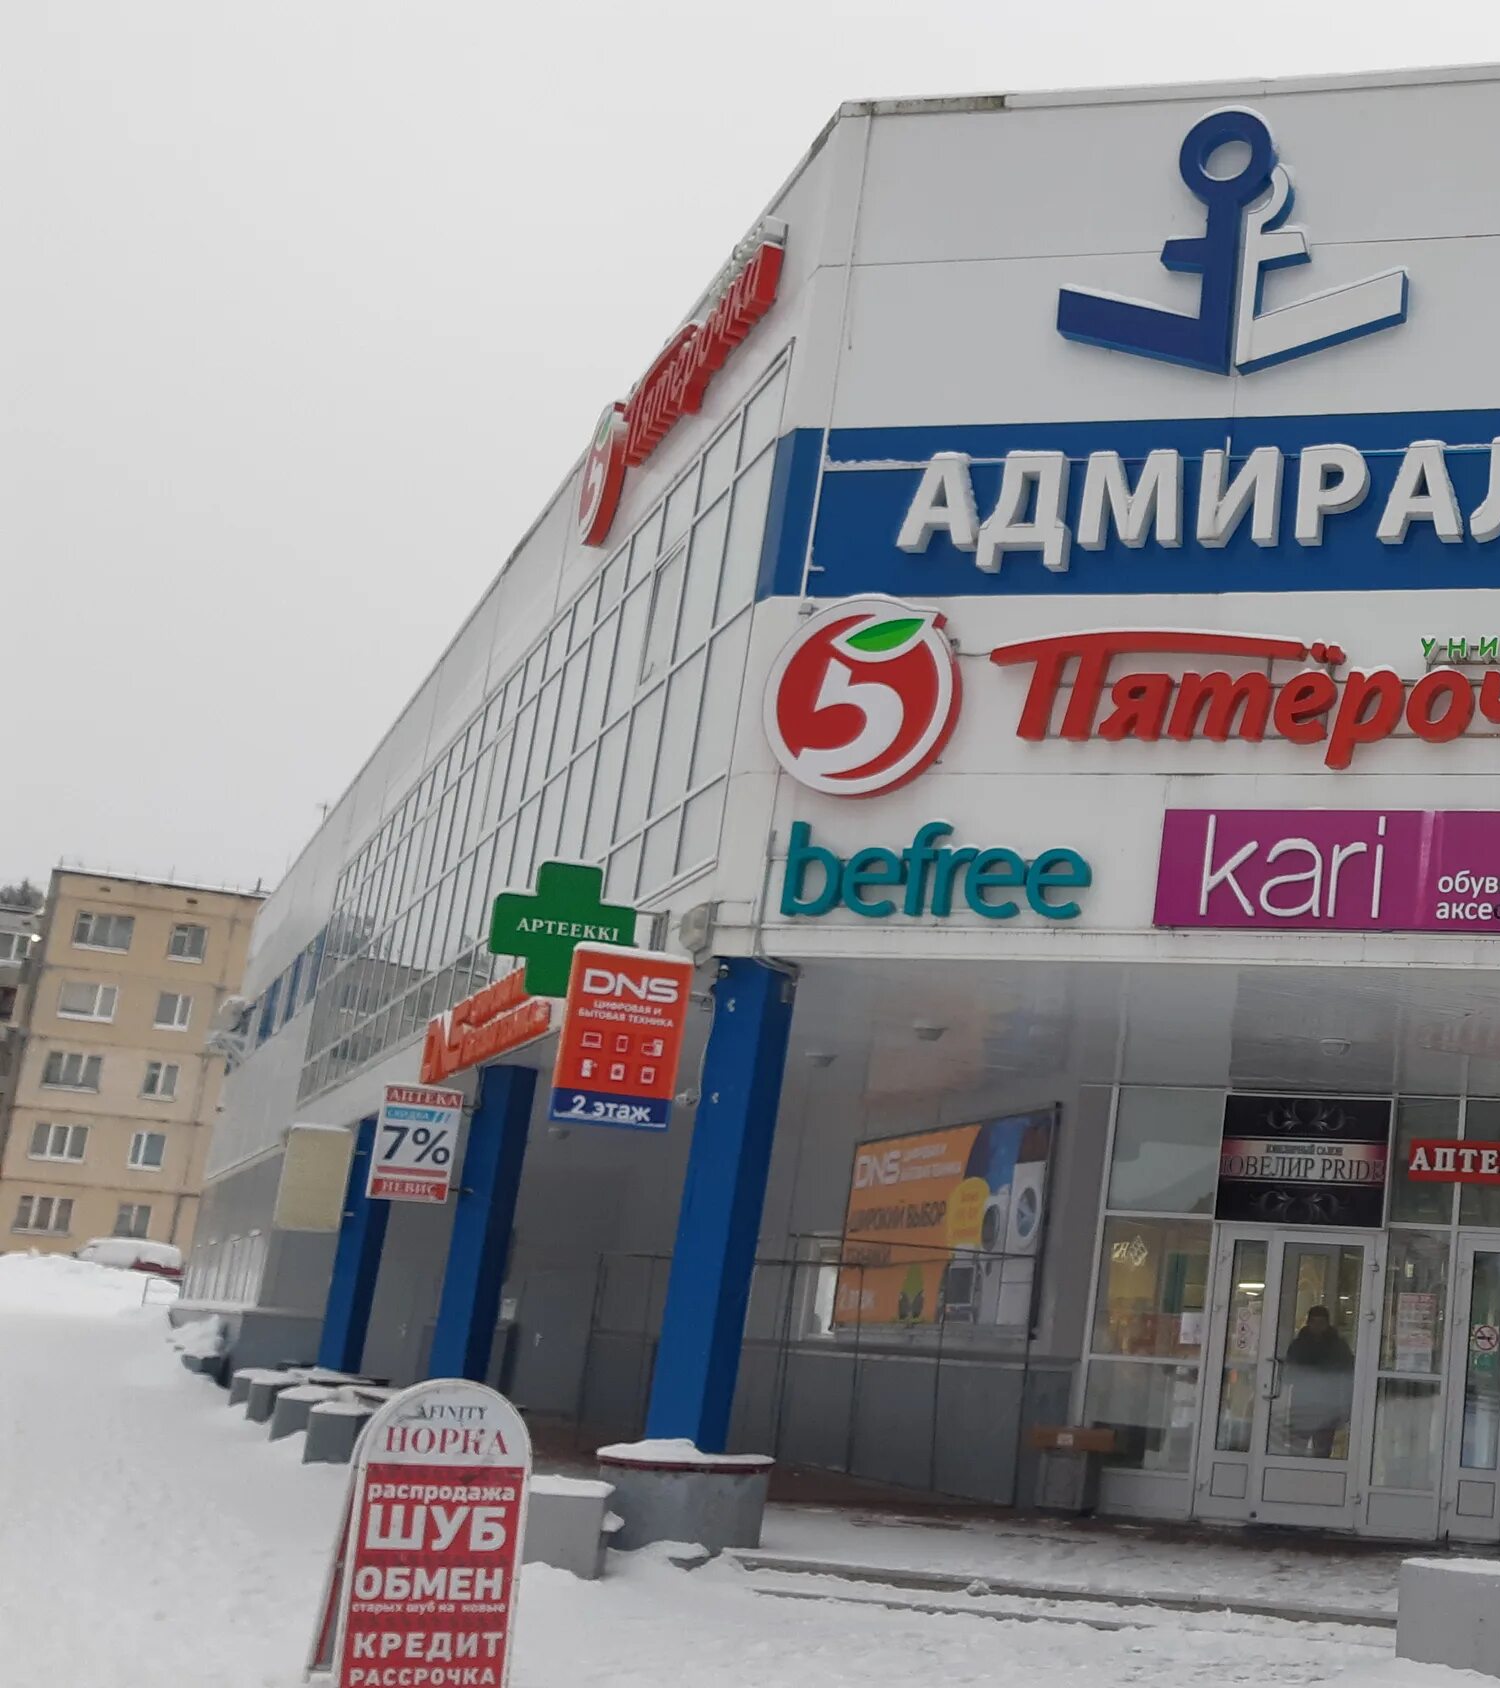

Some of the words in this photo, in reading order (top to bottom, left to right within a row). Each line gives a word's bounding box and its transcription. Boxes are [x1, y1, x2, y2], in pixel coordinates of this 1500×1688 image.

[780, 820, 1092, 919] befree
[1199, 814, 1387, 919] kari
[516, 917, 619, 942] APTEEKKI
[583, 968, 679, 1003] DNS
[578, 1007, 626, 1022] БЫТОВАЯ
[629, 1014, 674, 1028] ТЕХНИКА
[389, 1087, 461, 1106] АПТЕКА
[571, 1094, 587, 1115] 2
[591, 1101, 652, 1122] этаж
[383, 1125, 450, 1165] 7%
[854, 1150, 901, 1189] DNS
[368, 1483, 515, 1504] распродажа
[365, 1503, 507, 1552] ШУБ
[354, 1566, 504, 1602] ОБМЕН
[352, 1602, 402, 1615] старых
[406, 1600, 436, 1615] шуб
[353, 1632, 504, 1663] КРЕДИТ
[349, 1667, 496, 1687] РАССРОЧКА
